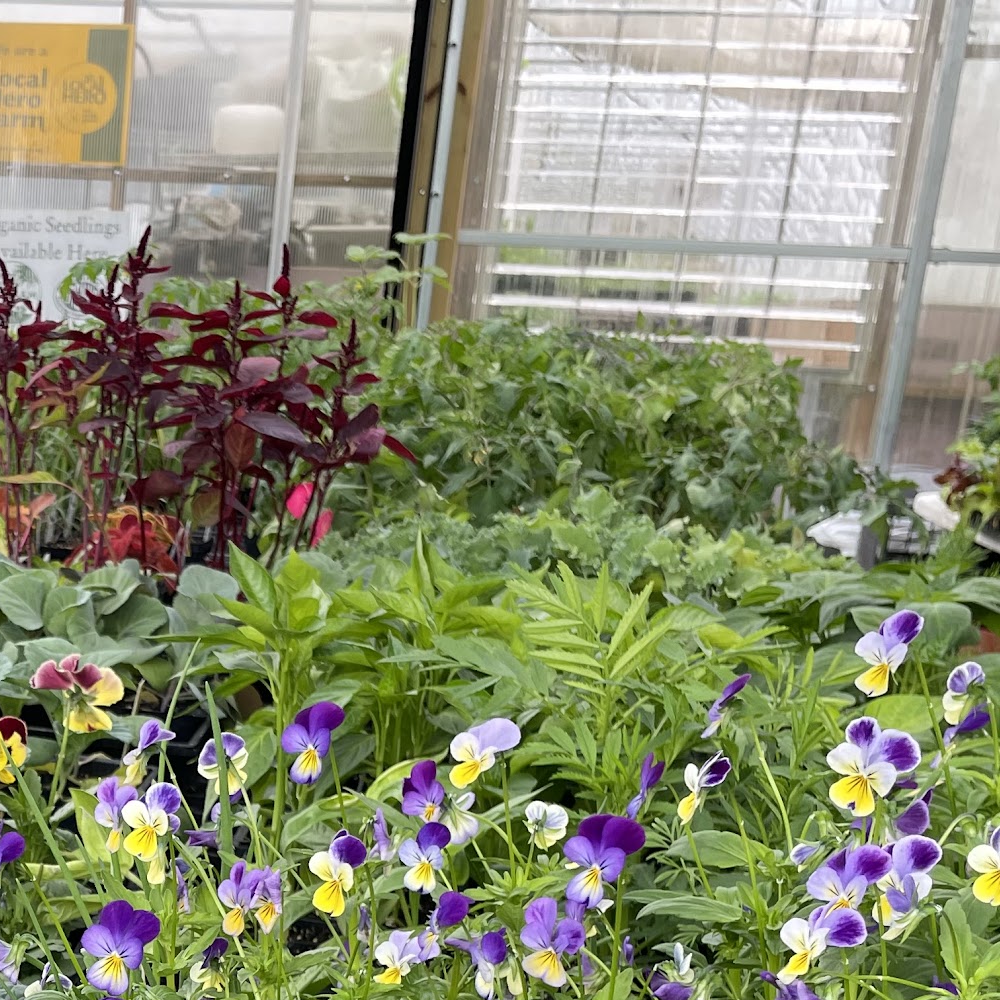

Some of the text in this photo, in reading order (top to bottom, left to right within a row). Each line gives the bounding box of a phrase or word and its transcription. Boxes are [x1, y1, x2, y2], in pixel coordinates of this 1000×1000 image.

[14, 47, 35, 57] are
[39, 47, 48, 57] a
[46, 216, 121, 240] Seedlings
